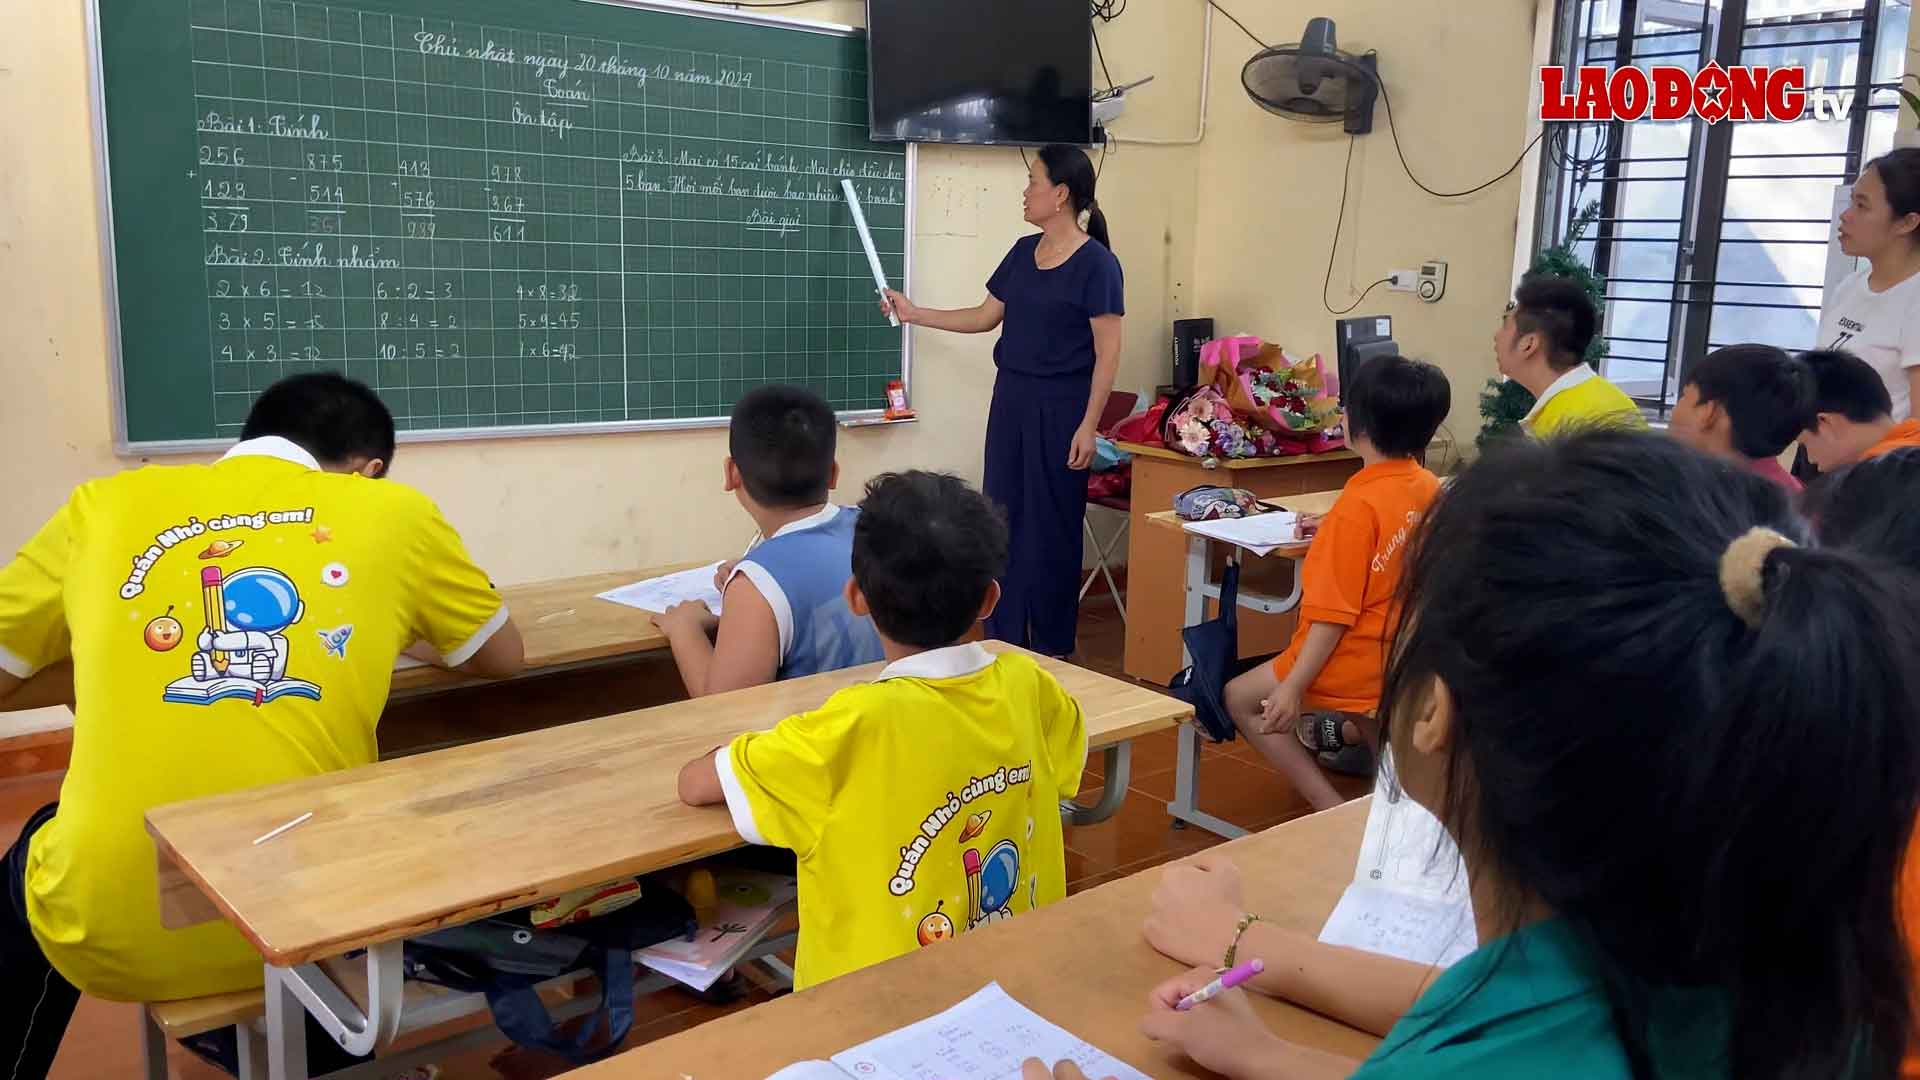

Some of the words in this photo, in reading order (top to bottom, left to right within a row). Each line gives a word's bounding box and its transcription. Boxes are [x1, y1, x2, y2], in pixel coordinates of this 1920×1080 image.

[414, 31, 459, 56] Chủ
[465, 40, 515, 69] nhật
[574, 52, 597, 72] 20
[598, 56, 648, 88] tháng
[651, 64, 670, 80] 10
[673, 68, 713, 84] năm
[717, 68, 752, 88] 2024
[512, 101, 536, 124] Ôn
[268, 113, 329, 139] Tính
[200, 145, 245, 166] 256
[306, 153, 343, 171] 875
[724, 153, 739, 169] 15
[399, 159, 430, 177] 413
[491, 165, 522, 183] 978
[625, 174, 634, 190] 5
[309, 185, 344, 203] 514
[404, 191, 436, 208] 576
[207, 212, 248, 232] 379
[278, 241, 328, 266] Tính
[120, 545, 165, 599] Quán
[155, 517, 206, 549] Nhỏ
[207, 511, 267, 530] cùng
[267, 507, 314, 524] em!
[889, 834, 931, 896] Quán
[920, 791, 962, 839] Nhỏ
[961, 766, 1008, 804] cùng
